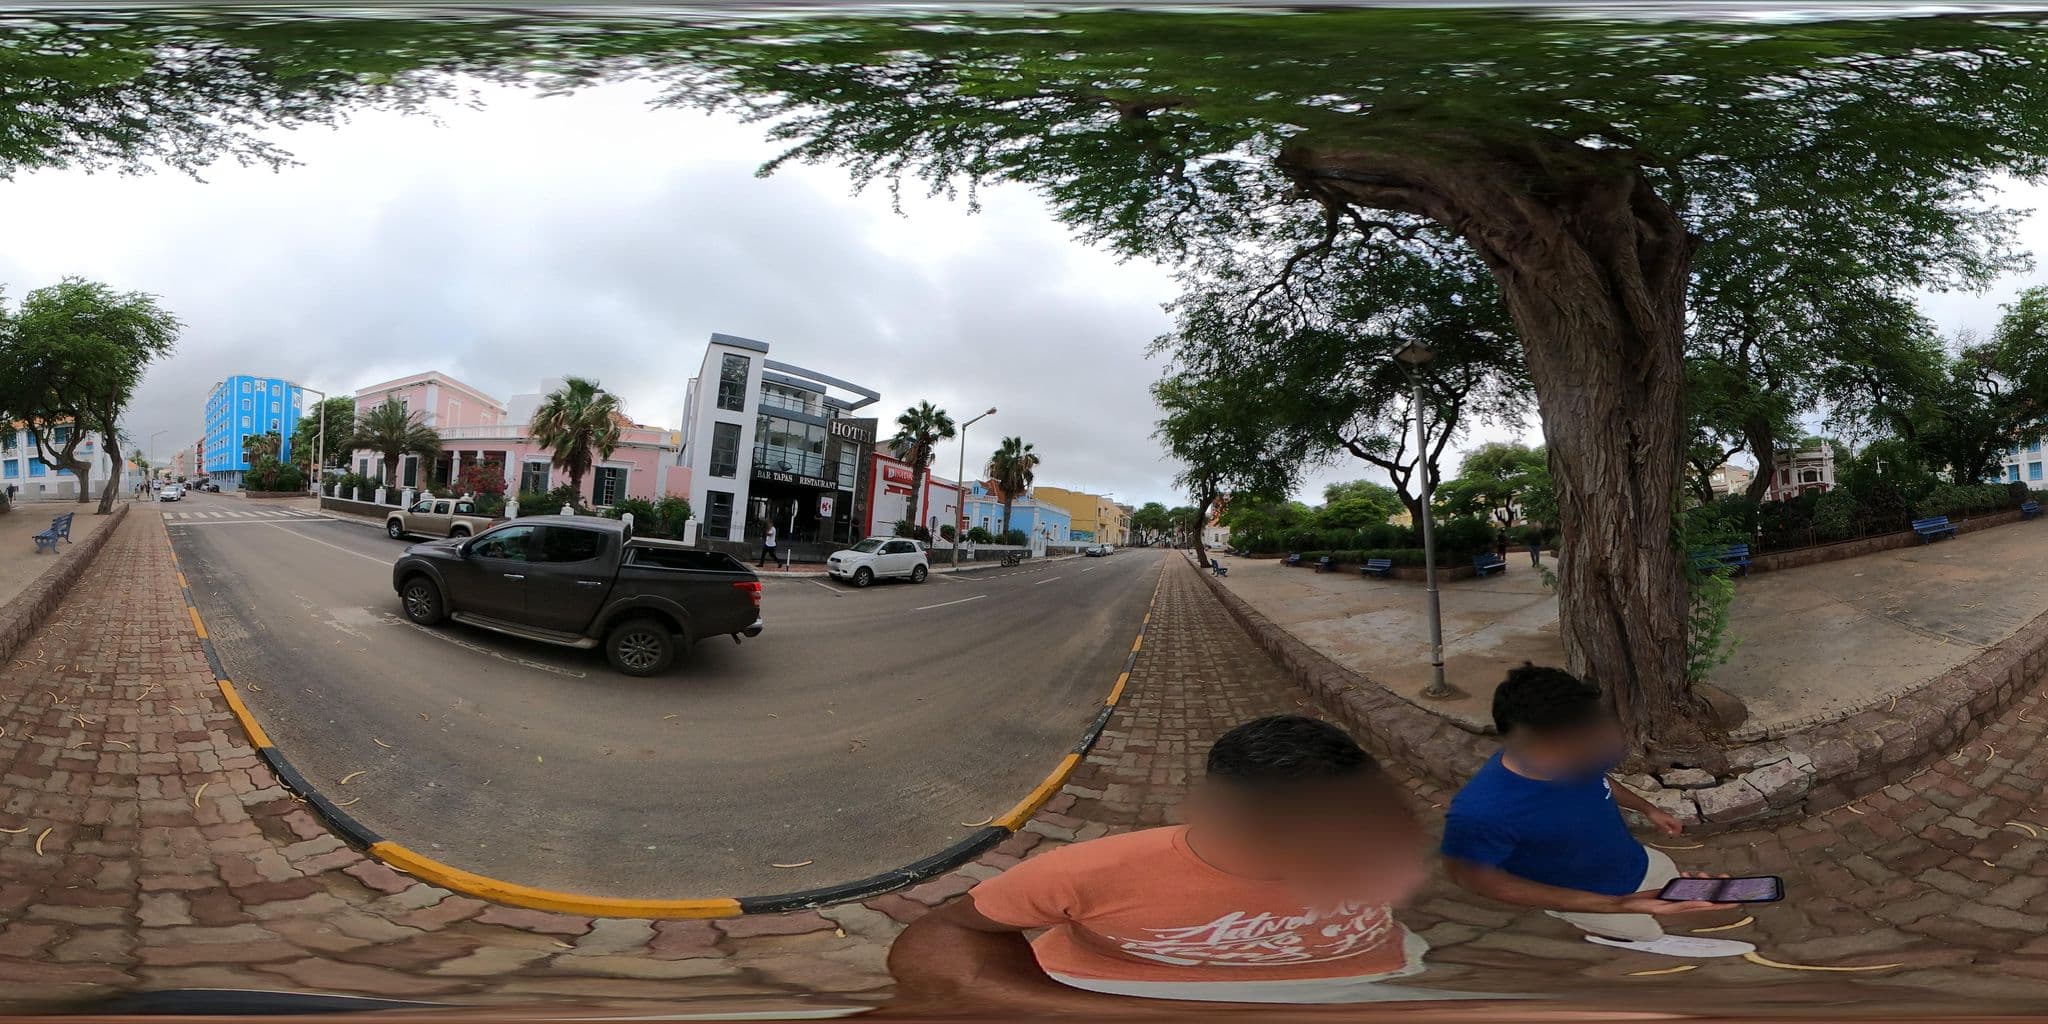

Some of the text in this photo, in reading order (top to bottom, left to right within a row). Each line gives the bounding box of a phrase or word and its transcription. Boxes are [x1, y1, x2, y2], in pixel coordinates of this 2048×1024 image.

[831, 421, 875, 445] HOTEL
[757, 470, 837, 490] BAR TAPAS RESTAURANT
